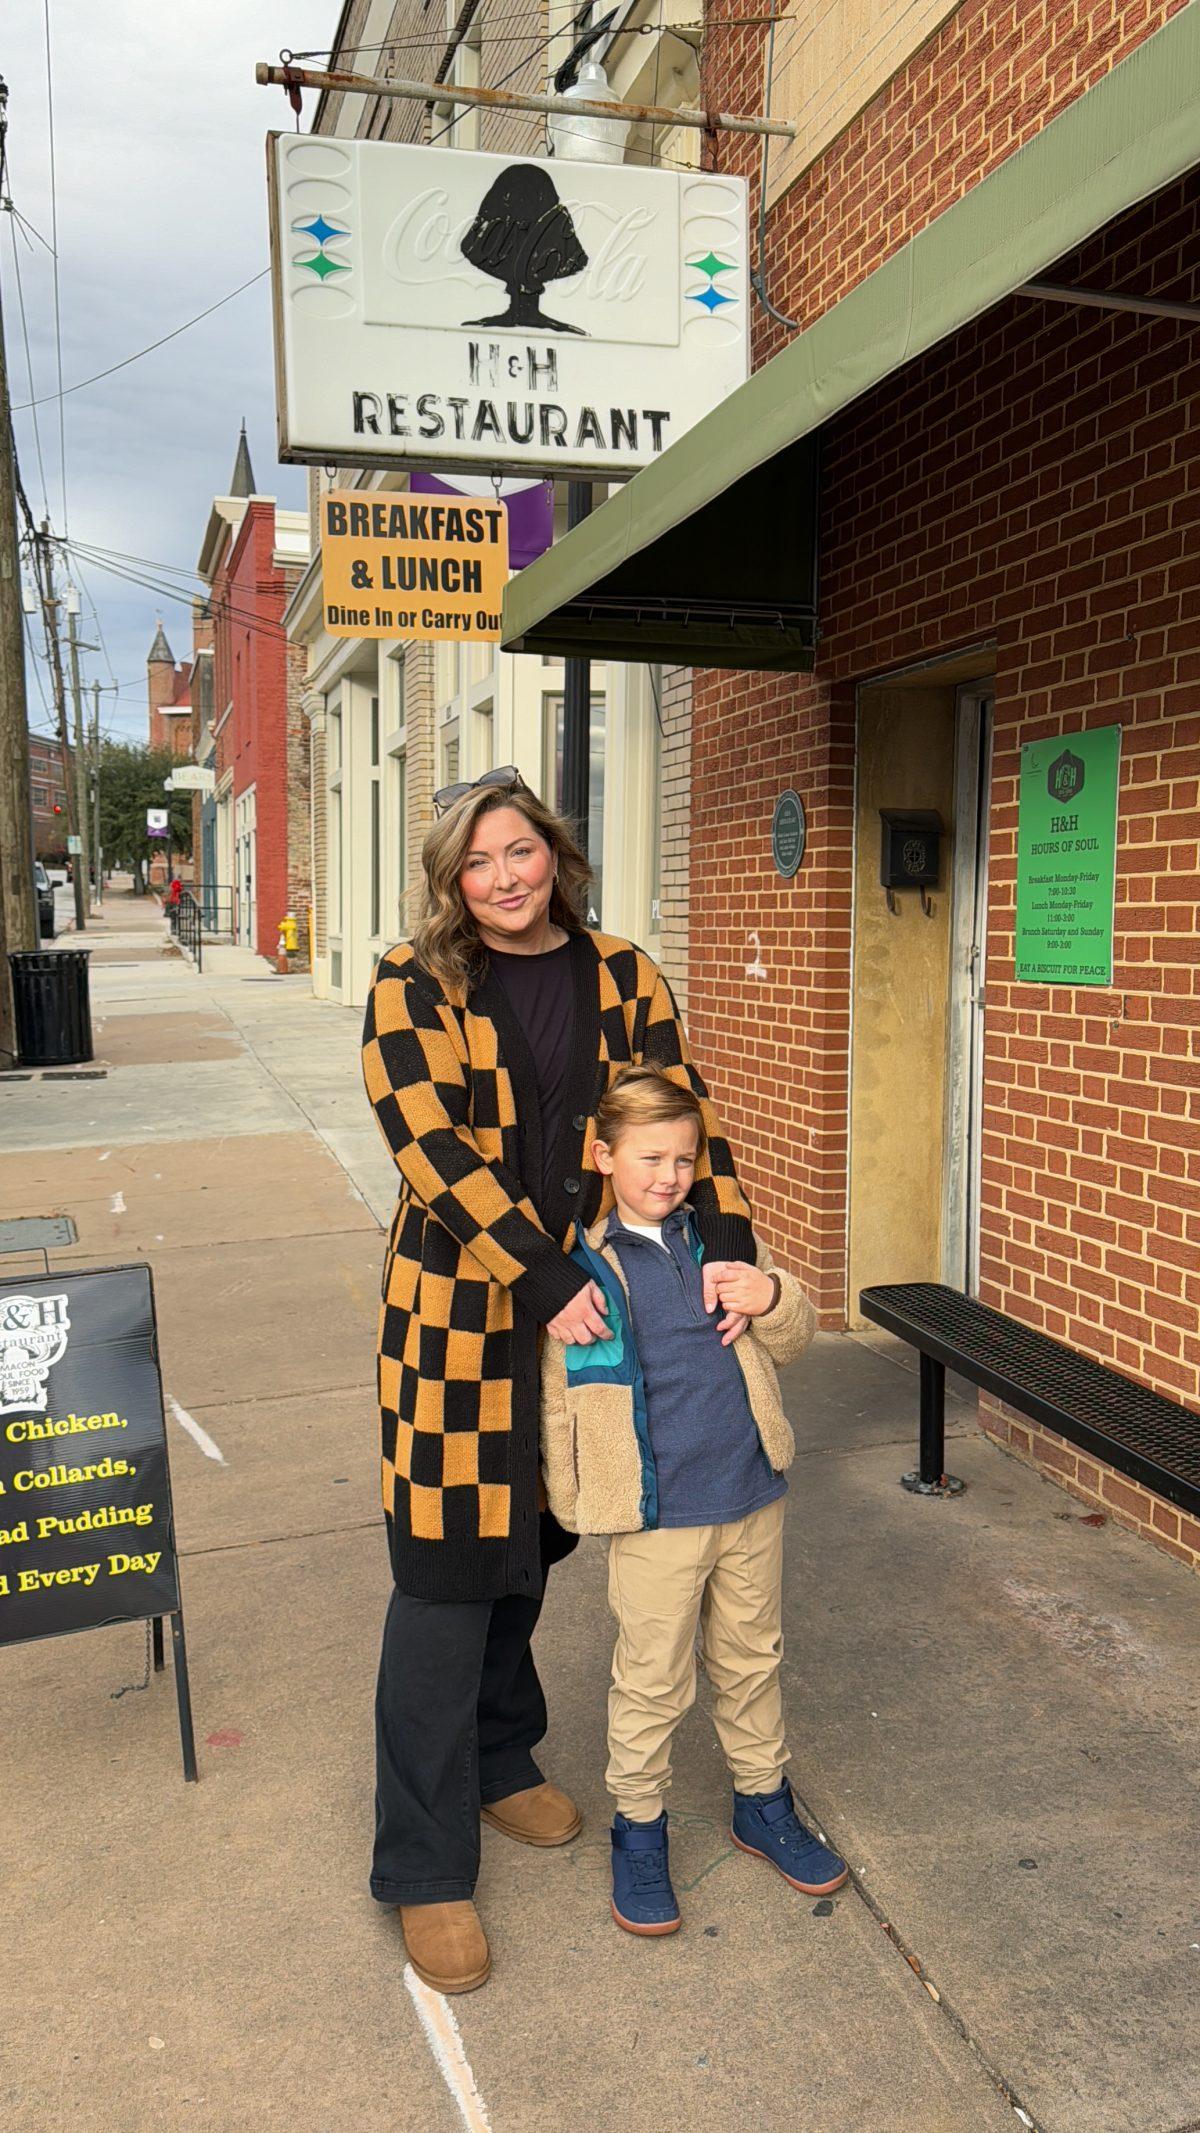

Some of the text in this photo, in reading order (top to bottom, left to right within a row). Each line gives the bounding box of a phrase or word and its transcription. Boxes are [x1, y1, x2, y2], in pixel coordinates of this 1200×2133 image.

[352, 390, 671, 452] RESTAURANT
[327, 501, 502, 544] BREAKFAST
[351, 555, 482, 594] & LUNCH
[327, 604, 370, 627] Dine
[375, 607, 393, 627] In
[398, 610, 417, 628] or
[421, 608, 471, 631] Carry
[1050, 814, 1079, 833] H&H
[1031, 838, 1099, 855] HOURS OF SOUL
[1028, 874, 1054, 884] Breakfast
[1031, 901, 1049, 910] Lunch
[1067, 927, 1079, 936] and
[1080, 927, 1104, 937] Sunday
[1020, 963, 1106, 976] EAT A BISCUIT FOR PEACE
[19, 1368, 44, 1377] FOOD
[8, 1379, 31, 1387] SINCE
[12, 1387, 29, 1395] 1959
[5, 1411, 128, 1443] Chicken,
[13, 1457, 137, 1492] Collards,
[36, 1503, 154, 1540] Pudding
[17, 1563, 101, 1593] Every
[107, 1551, 162, 1576] Day
